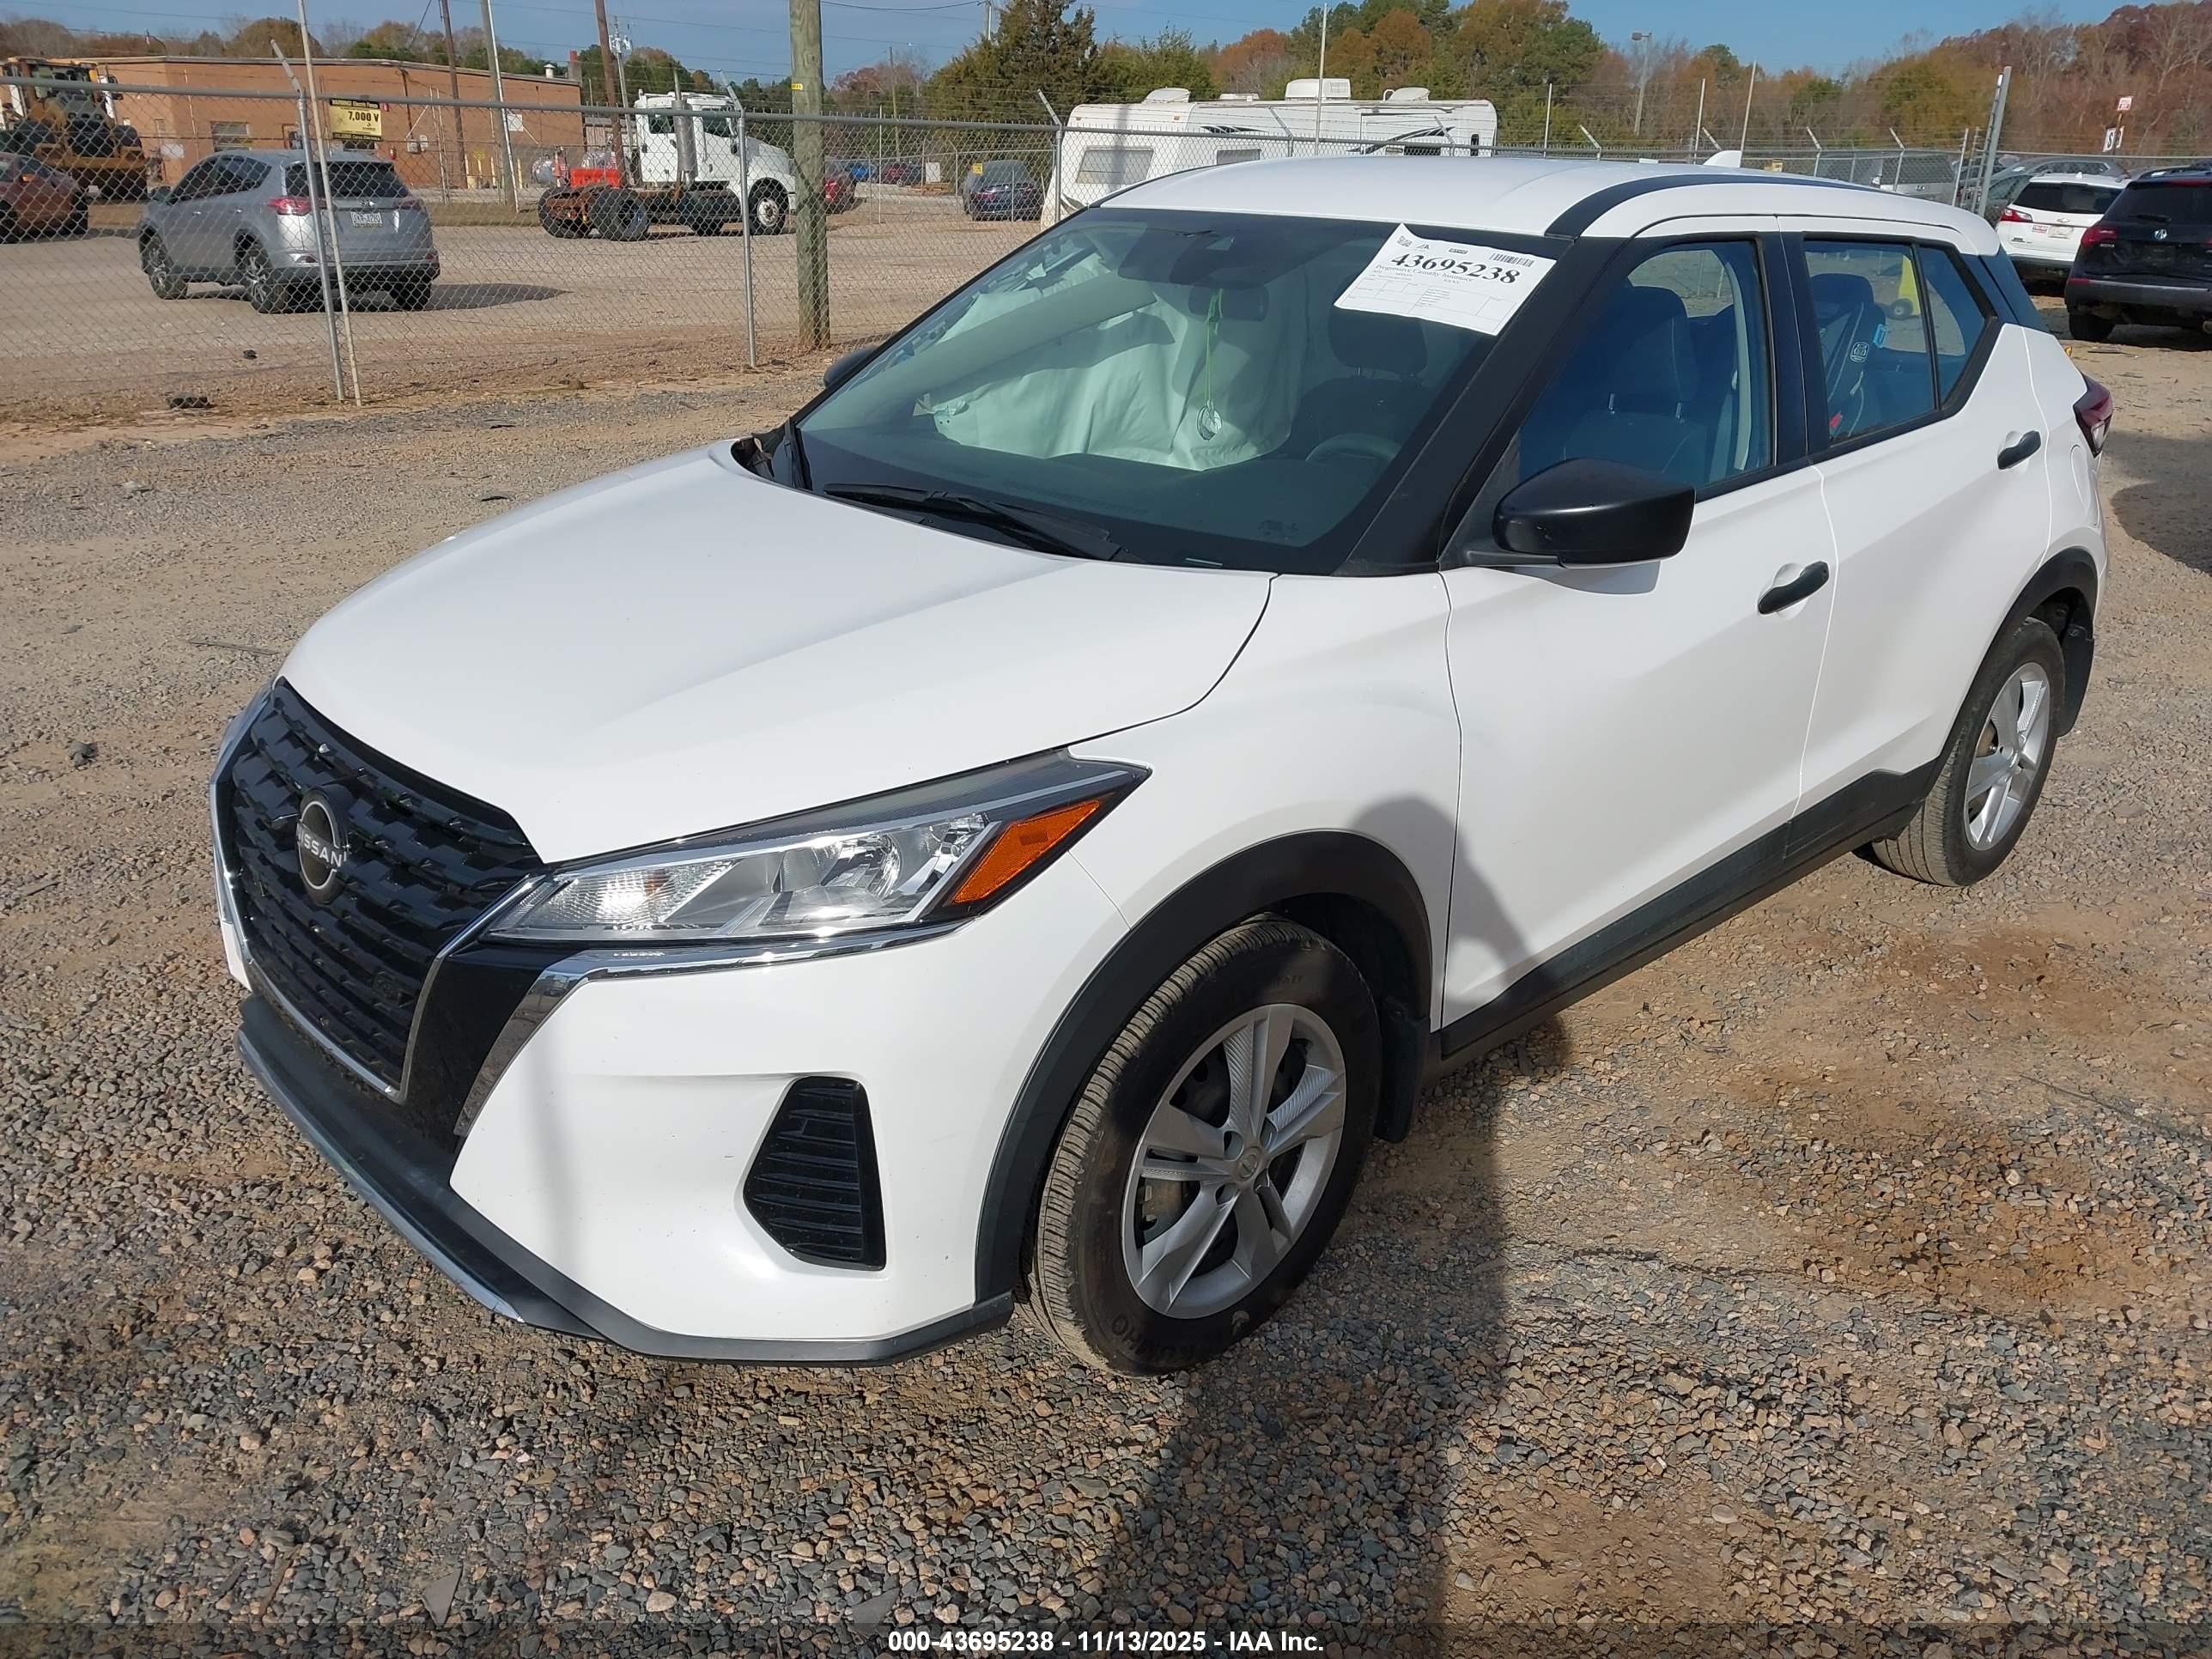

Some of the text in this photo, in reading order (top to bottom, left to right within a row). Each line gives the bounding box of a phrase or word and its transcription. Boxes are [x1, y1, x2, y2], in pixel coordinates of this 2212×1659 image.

[348, 111, 380, 123] 7,000 V
[1391, 253, 1520, 284] 43695238
[1442, 272, 1474, 283] Insurance
[296, 823, 342, 867] NISSAN
